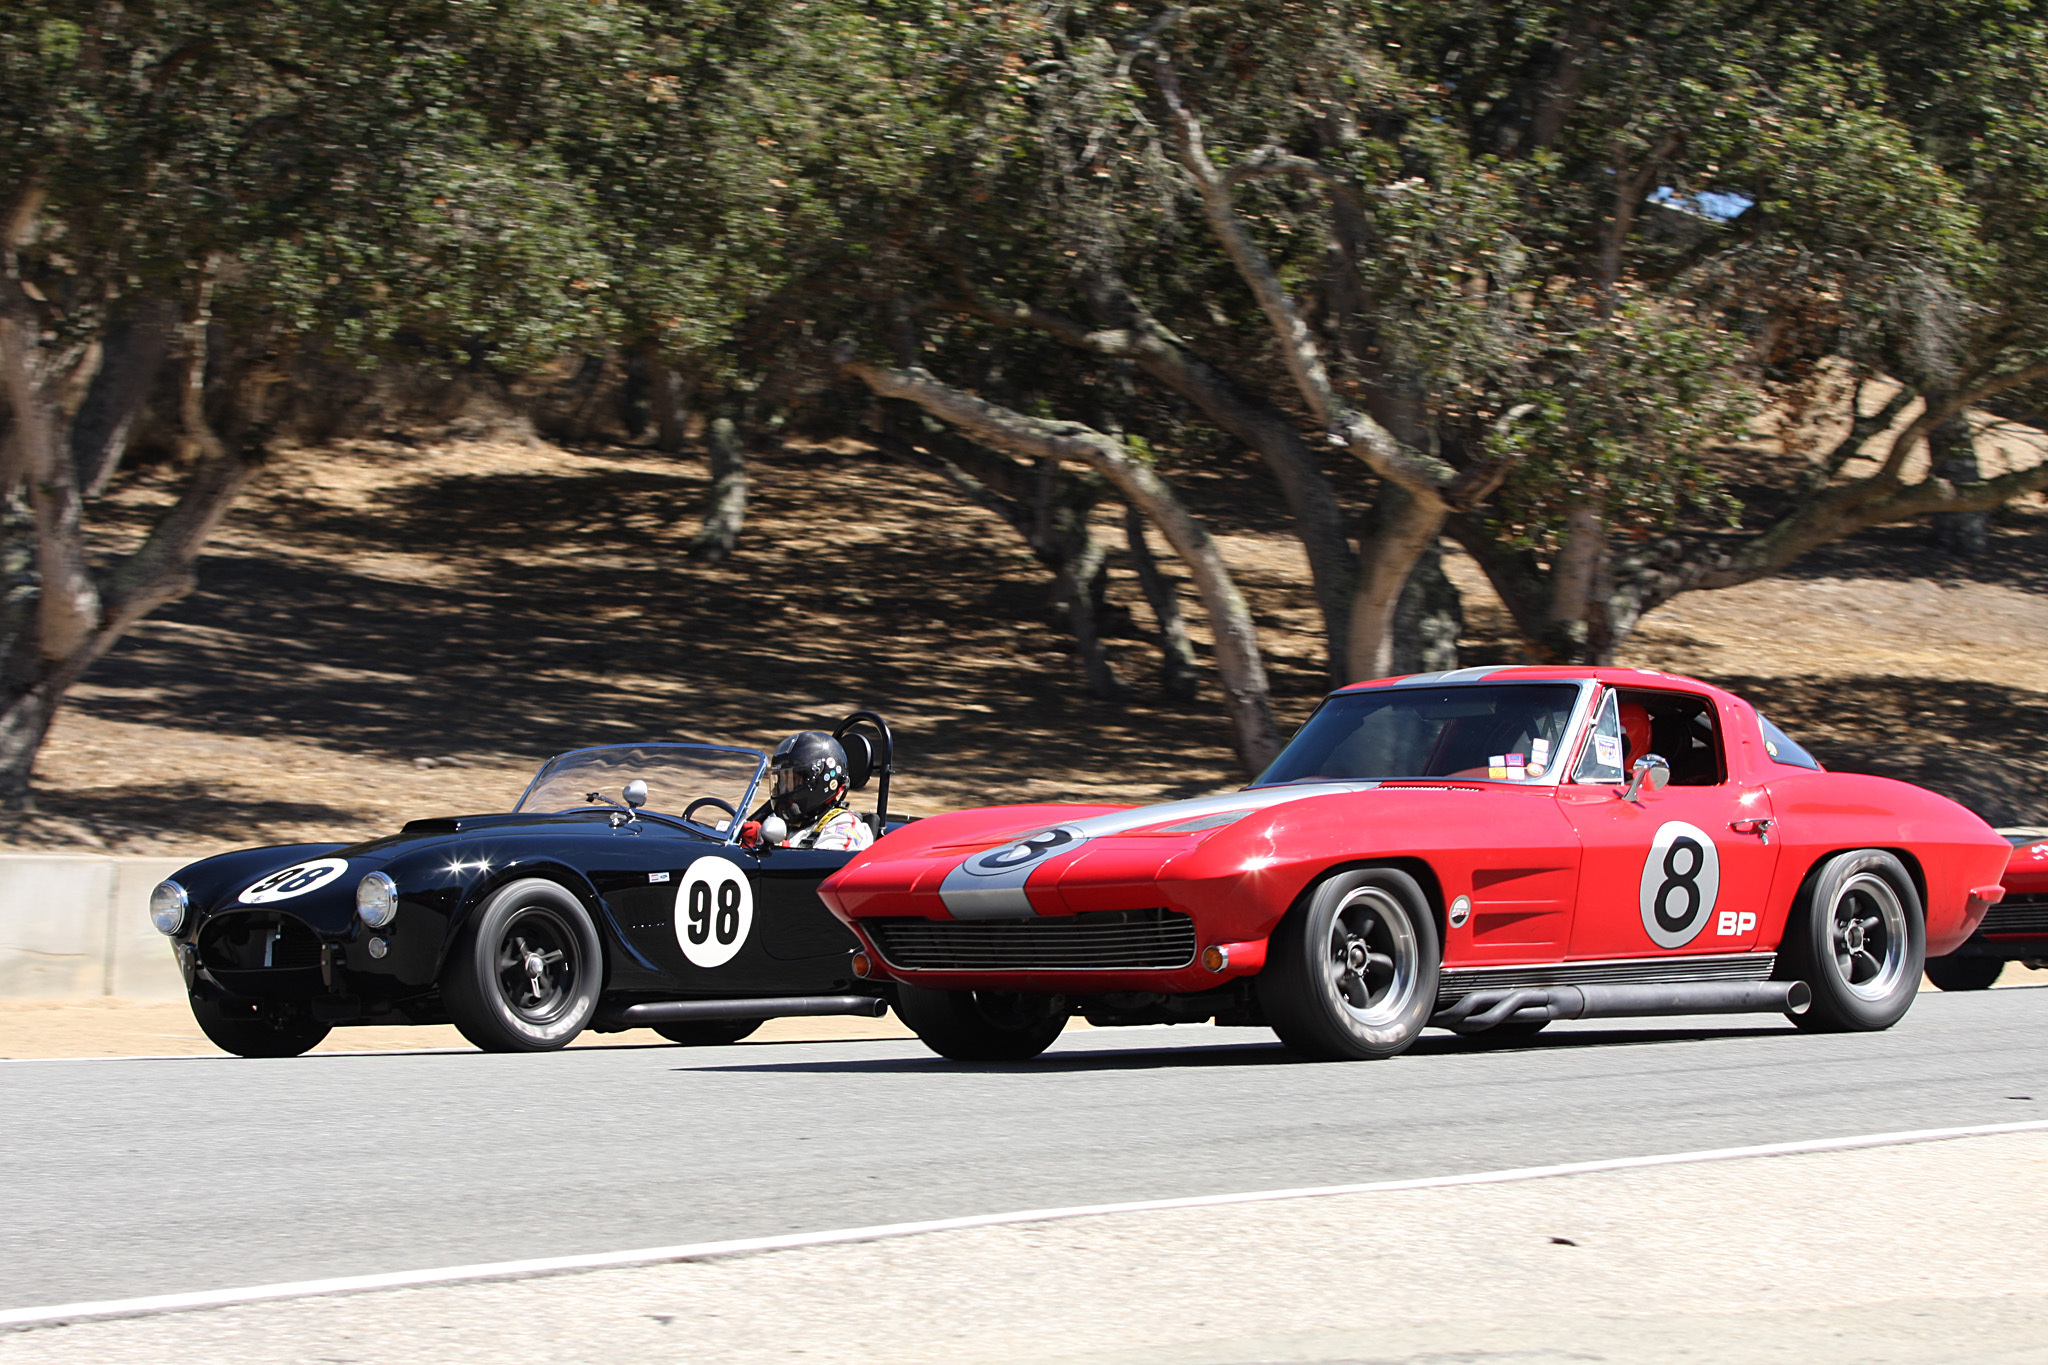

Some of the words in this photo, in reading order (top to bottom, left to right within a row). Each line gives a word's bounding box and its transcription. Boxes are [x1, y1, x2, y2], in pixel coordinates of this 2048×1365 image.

[979, 829, 1073, 868] 8
[251, 866, 334, 893] 98
[1654, 836, 1704, 933] 8
[688, 878, 741, 945] 98
[1716, 911, 1757, 936] BP
